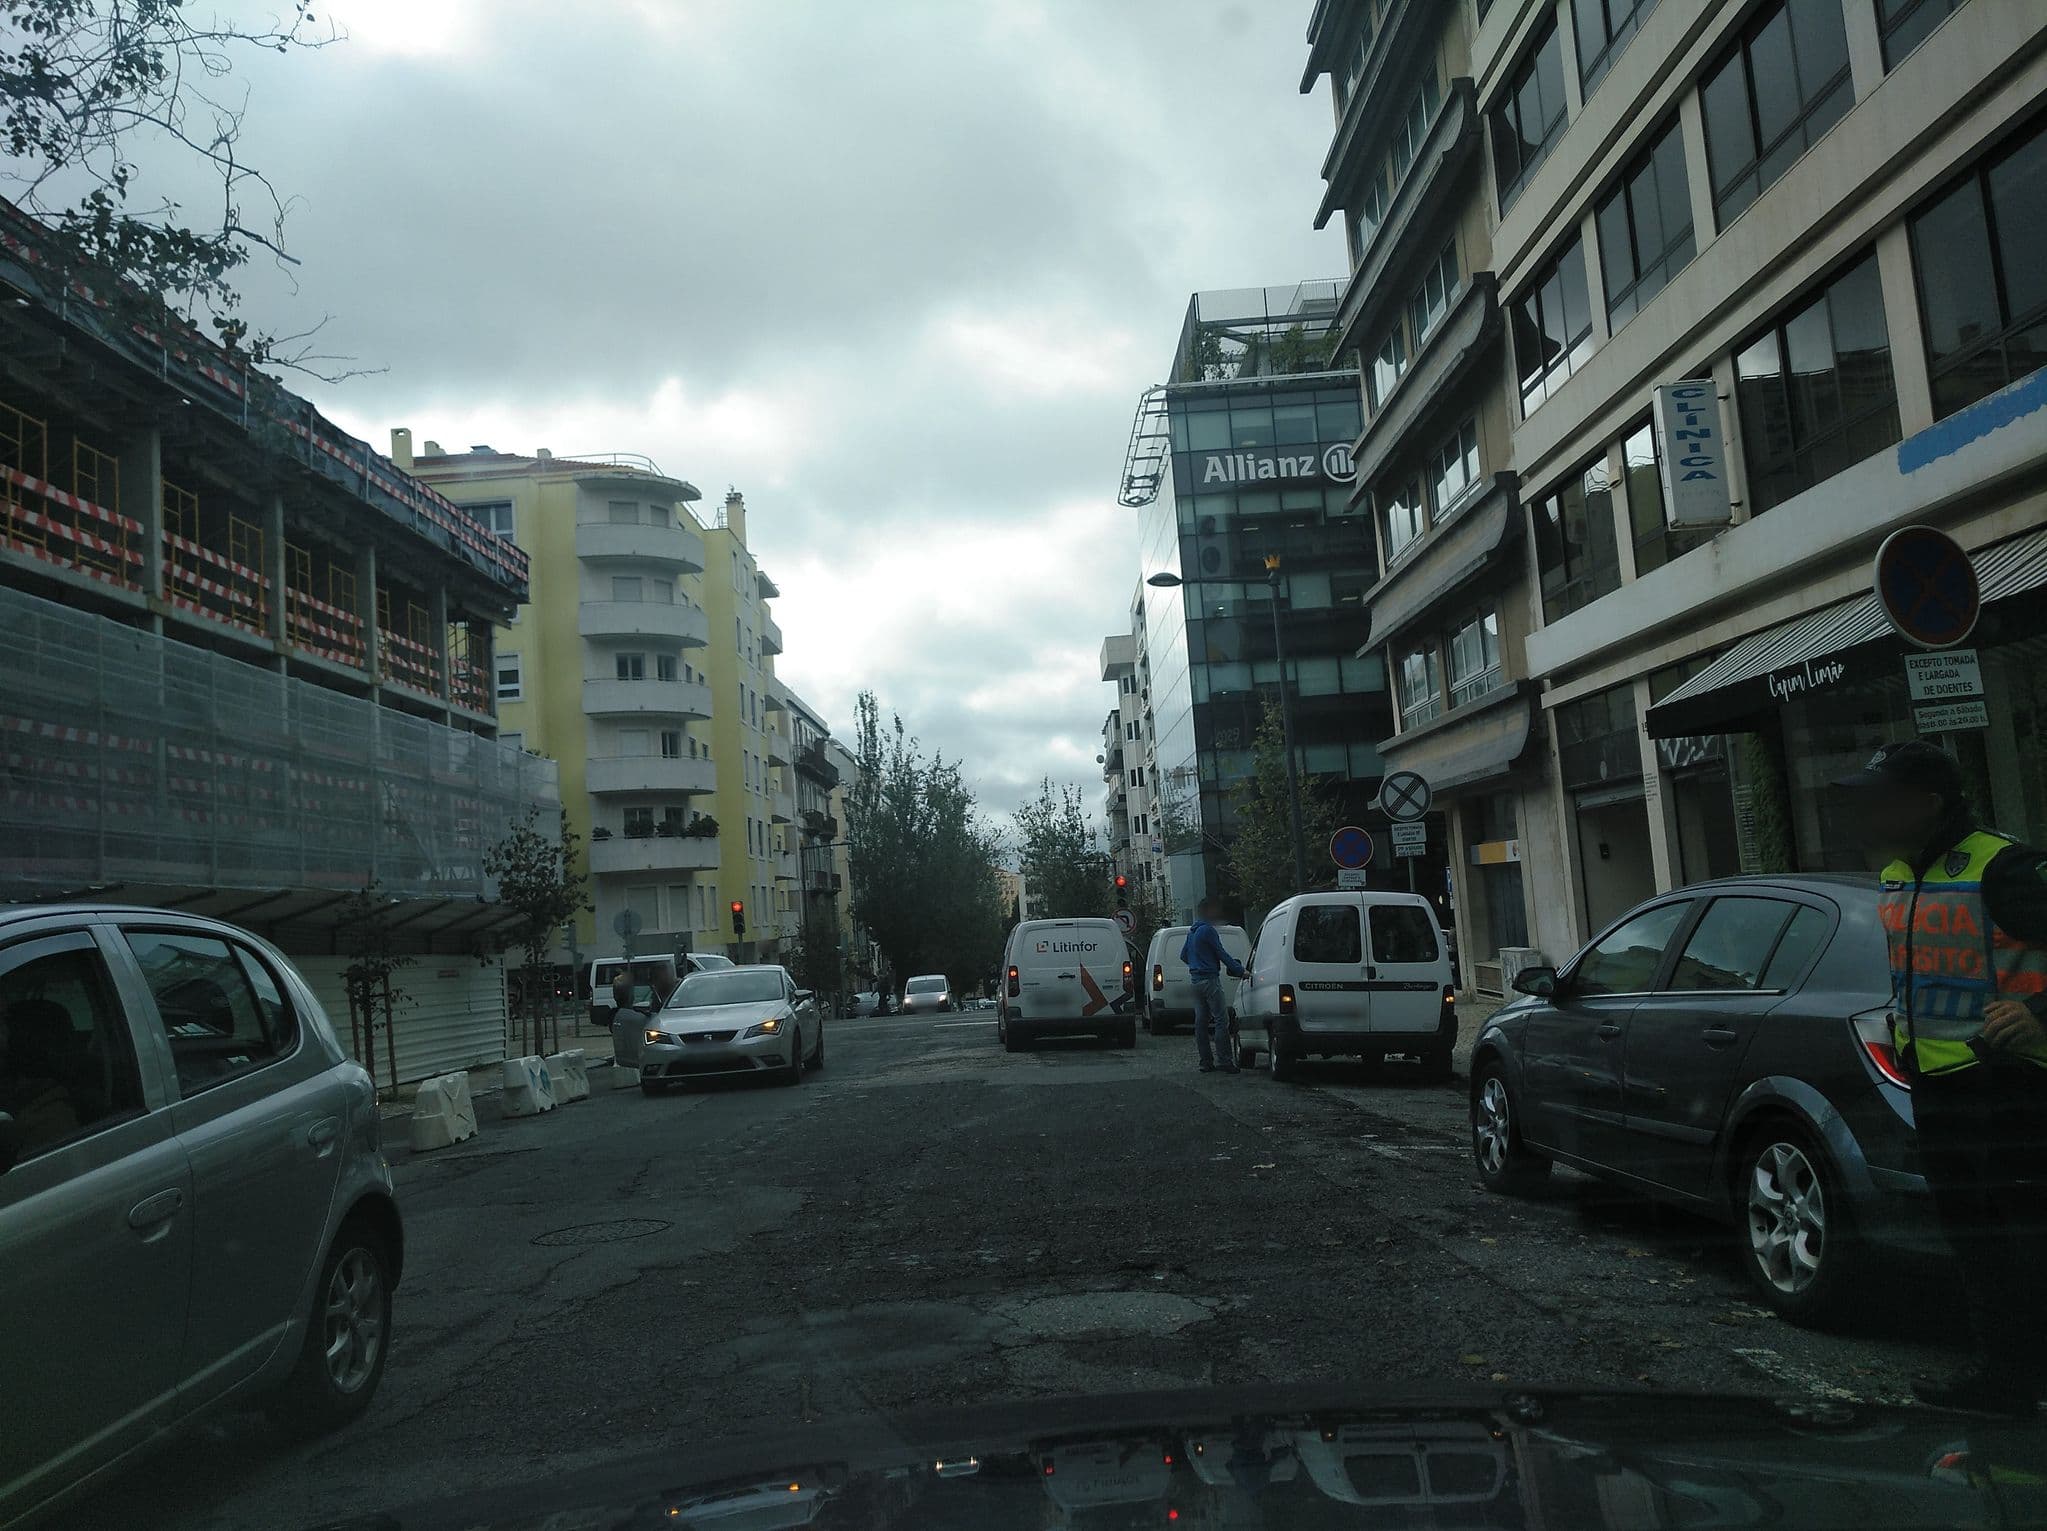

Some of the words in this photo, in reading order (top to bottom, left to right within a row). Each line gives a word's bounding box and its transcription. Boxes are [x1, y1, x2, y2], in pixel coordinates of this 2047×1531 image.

[1203, 453, 1316, 484] Allianz
[1909, 657, 1942, 669] EXCEPTO
[1943, 655, 1976, 667] TOMADA
[1918, 671, 1925, 681] E
[1925, 669, 1960, 681] LARGADA
[1924, 686, 1935, 696] DE
[1936, 682, 1973, 694] DOENTES
[1053, 940, 1098, 953] Litinfor
